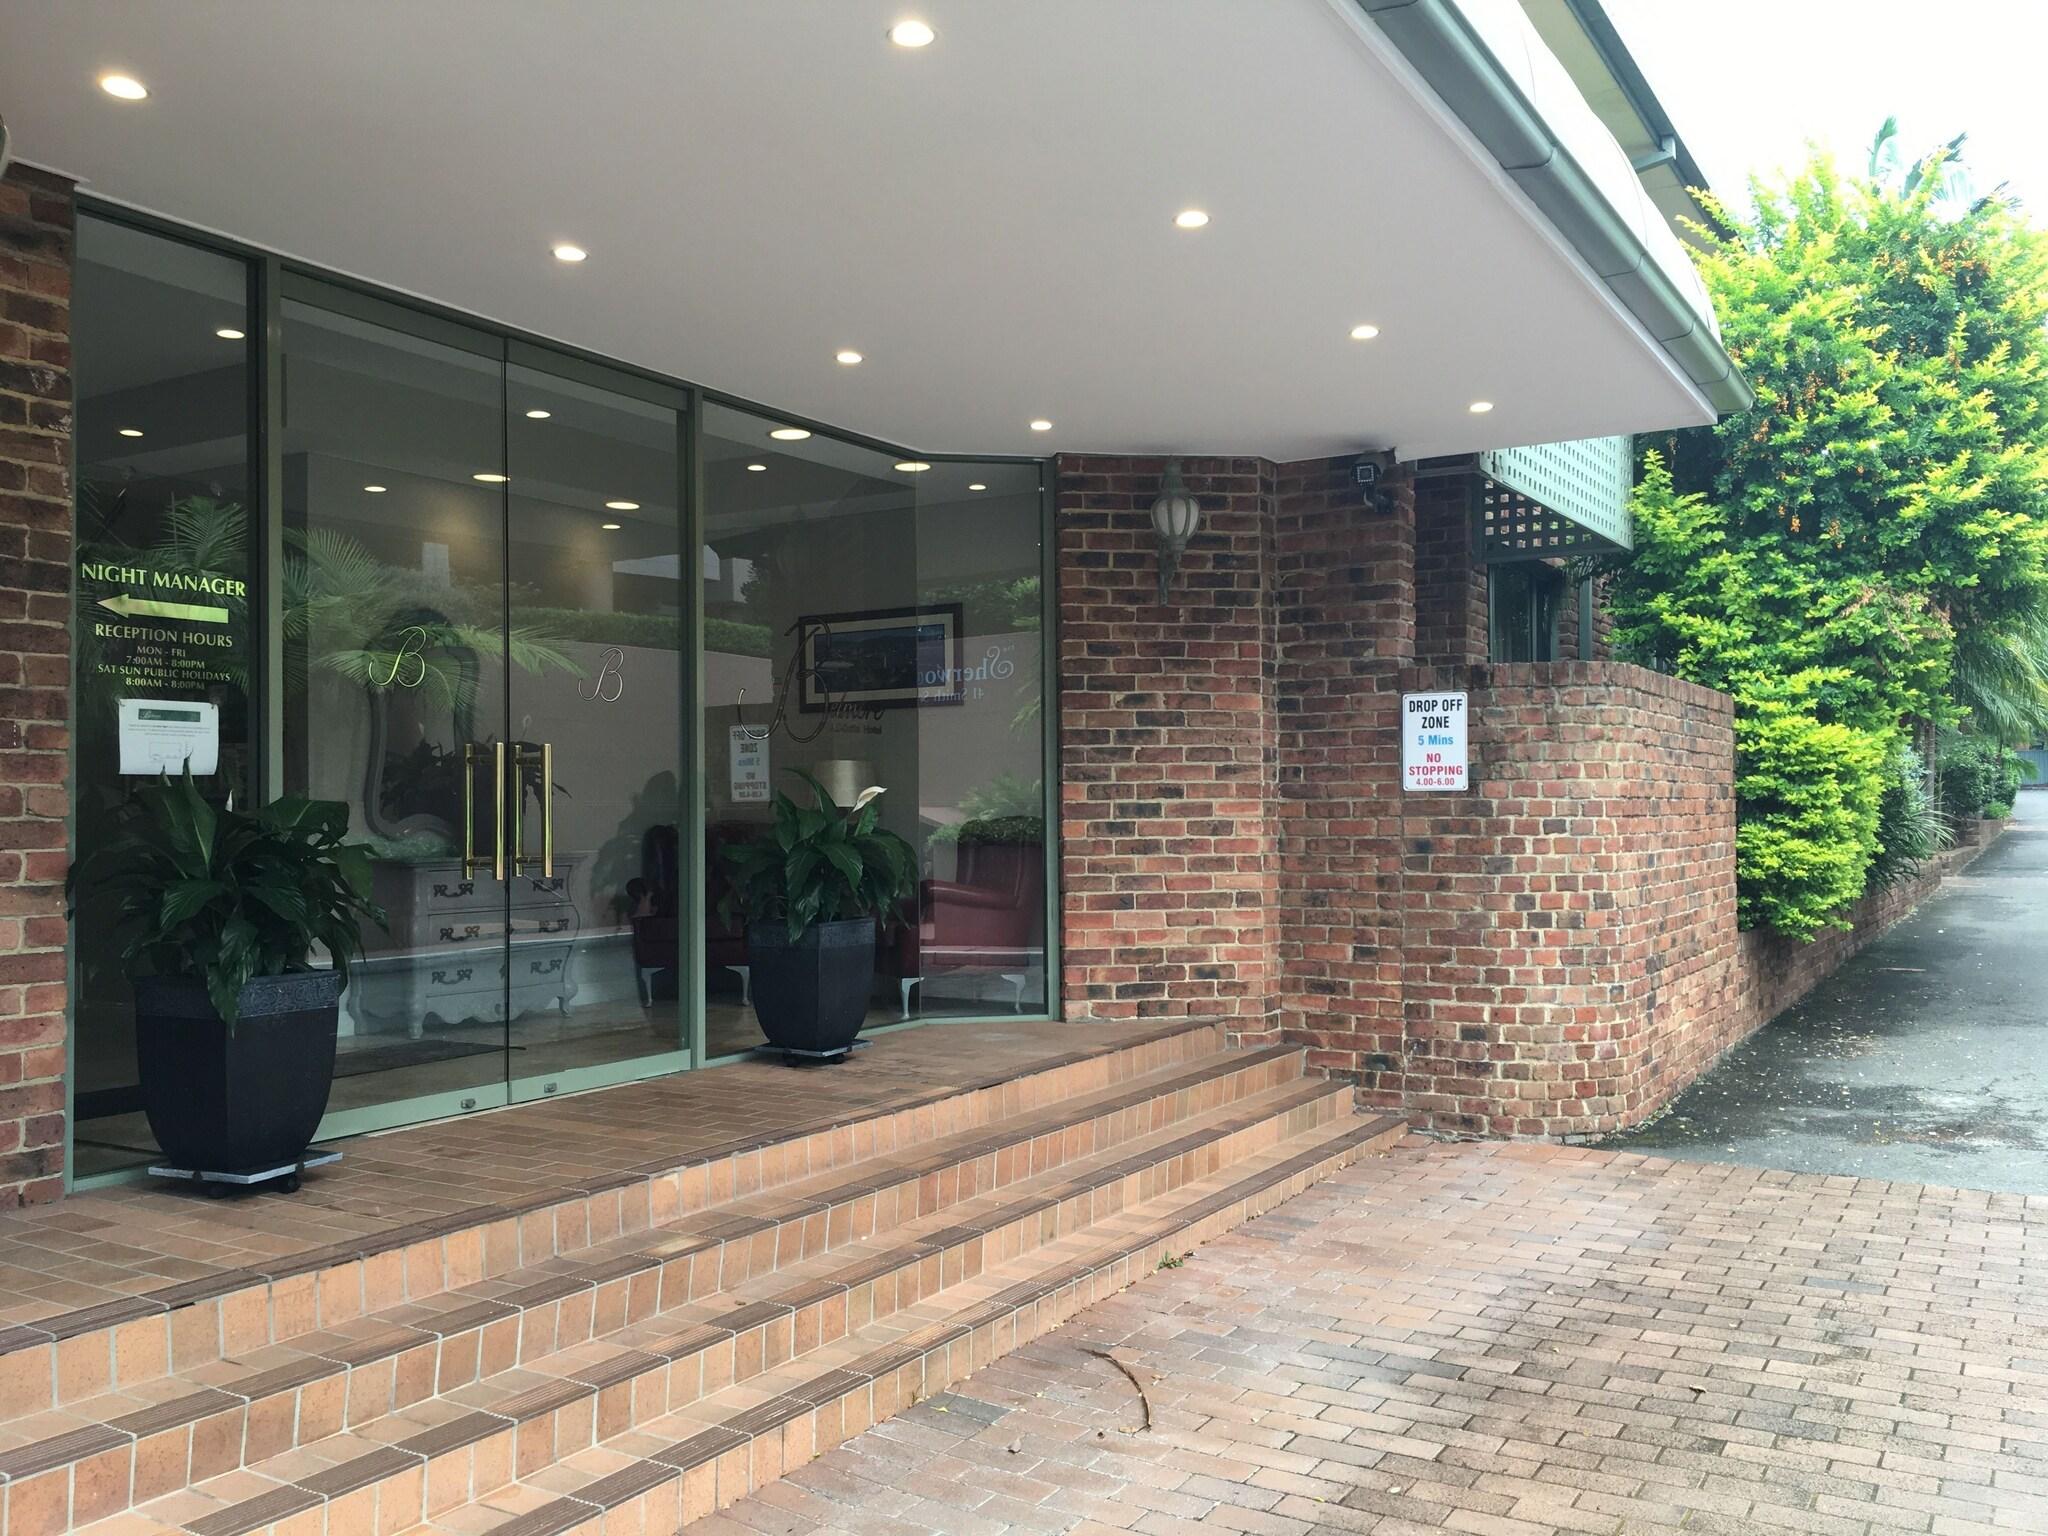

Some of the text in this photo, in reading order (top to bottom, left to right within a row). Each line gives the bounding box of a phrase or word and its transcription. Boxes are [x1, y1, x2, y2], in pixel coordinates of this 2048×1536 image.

[81, 562, 246, 596] NIGHT MANAGER
[95, 623, 233, 648] RECEPTION HOURS
[136, 645, 163, 655] MON
[171, 648, 186, 657] FRI
[368, 626, 427, 688] B
[126, 655, 163, 666] 7:00AM
[171, 659, 205, 669] 8:00PM
[98, 663, 231, 681] SAT SUN PUBLIC HOLIDAYS
[578, 647, 624, 702] B
[125, 677, 162, 688] 8:00AM
[171, 681, 205, 690] 8:00PM
[1409, 699, 1463, 713] DROP OFF
[1421, 716, 1450, 729] ZONE
[1418, 735, 1454, 746] 5 Mins
[1426, 753, 1441, 763] NO
[1409, 765, 1463, 776] STOPPING
[1416, 777, 1455, 786] 4.00-6.00
